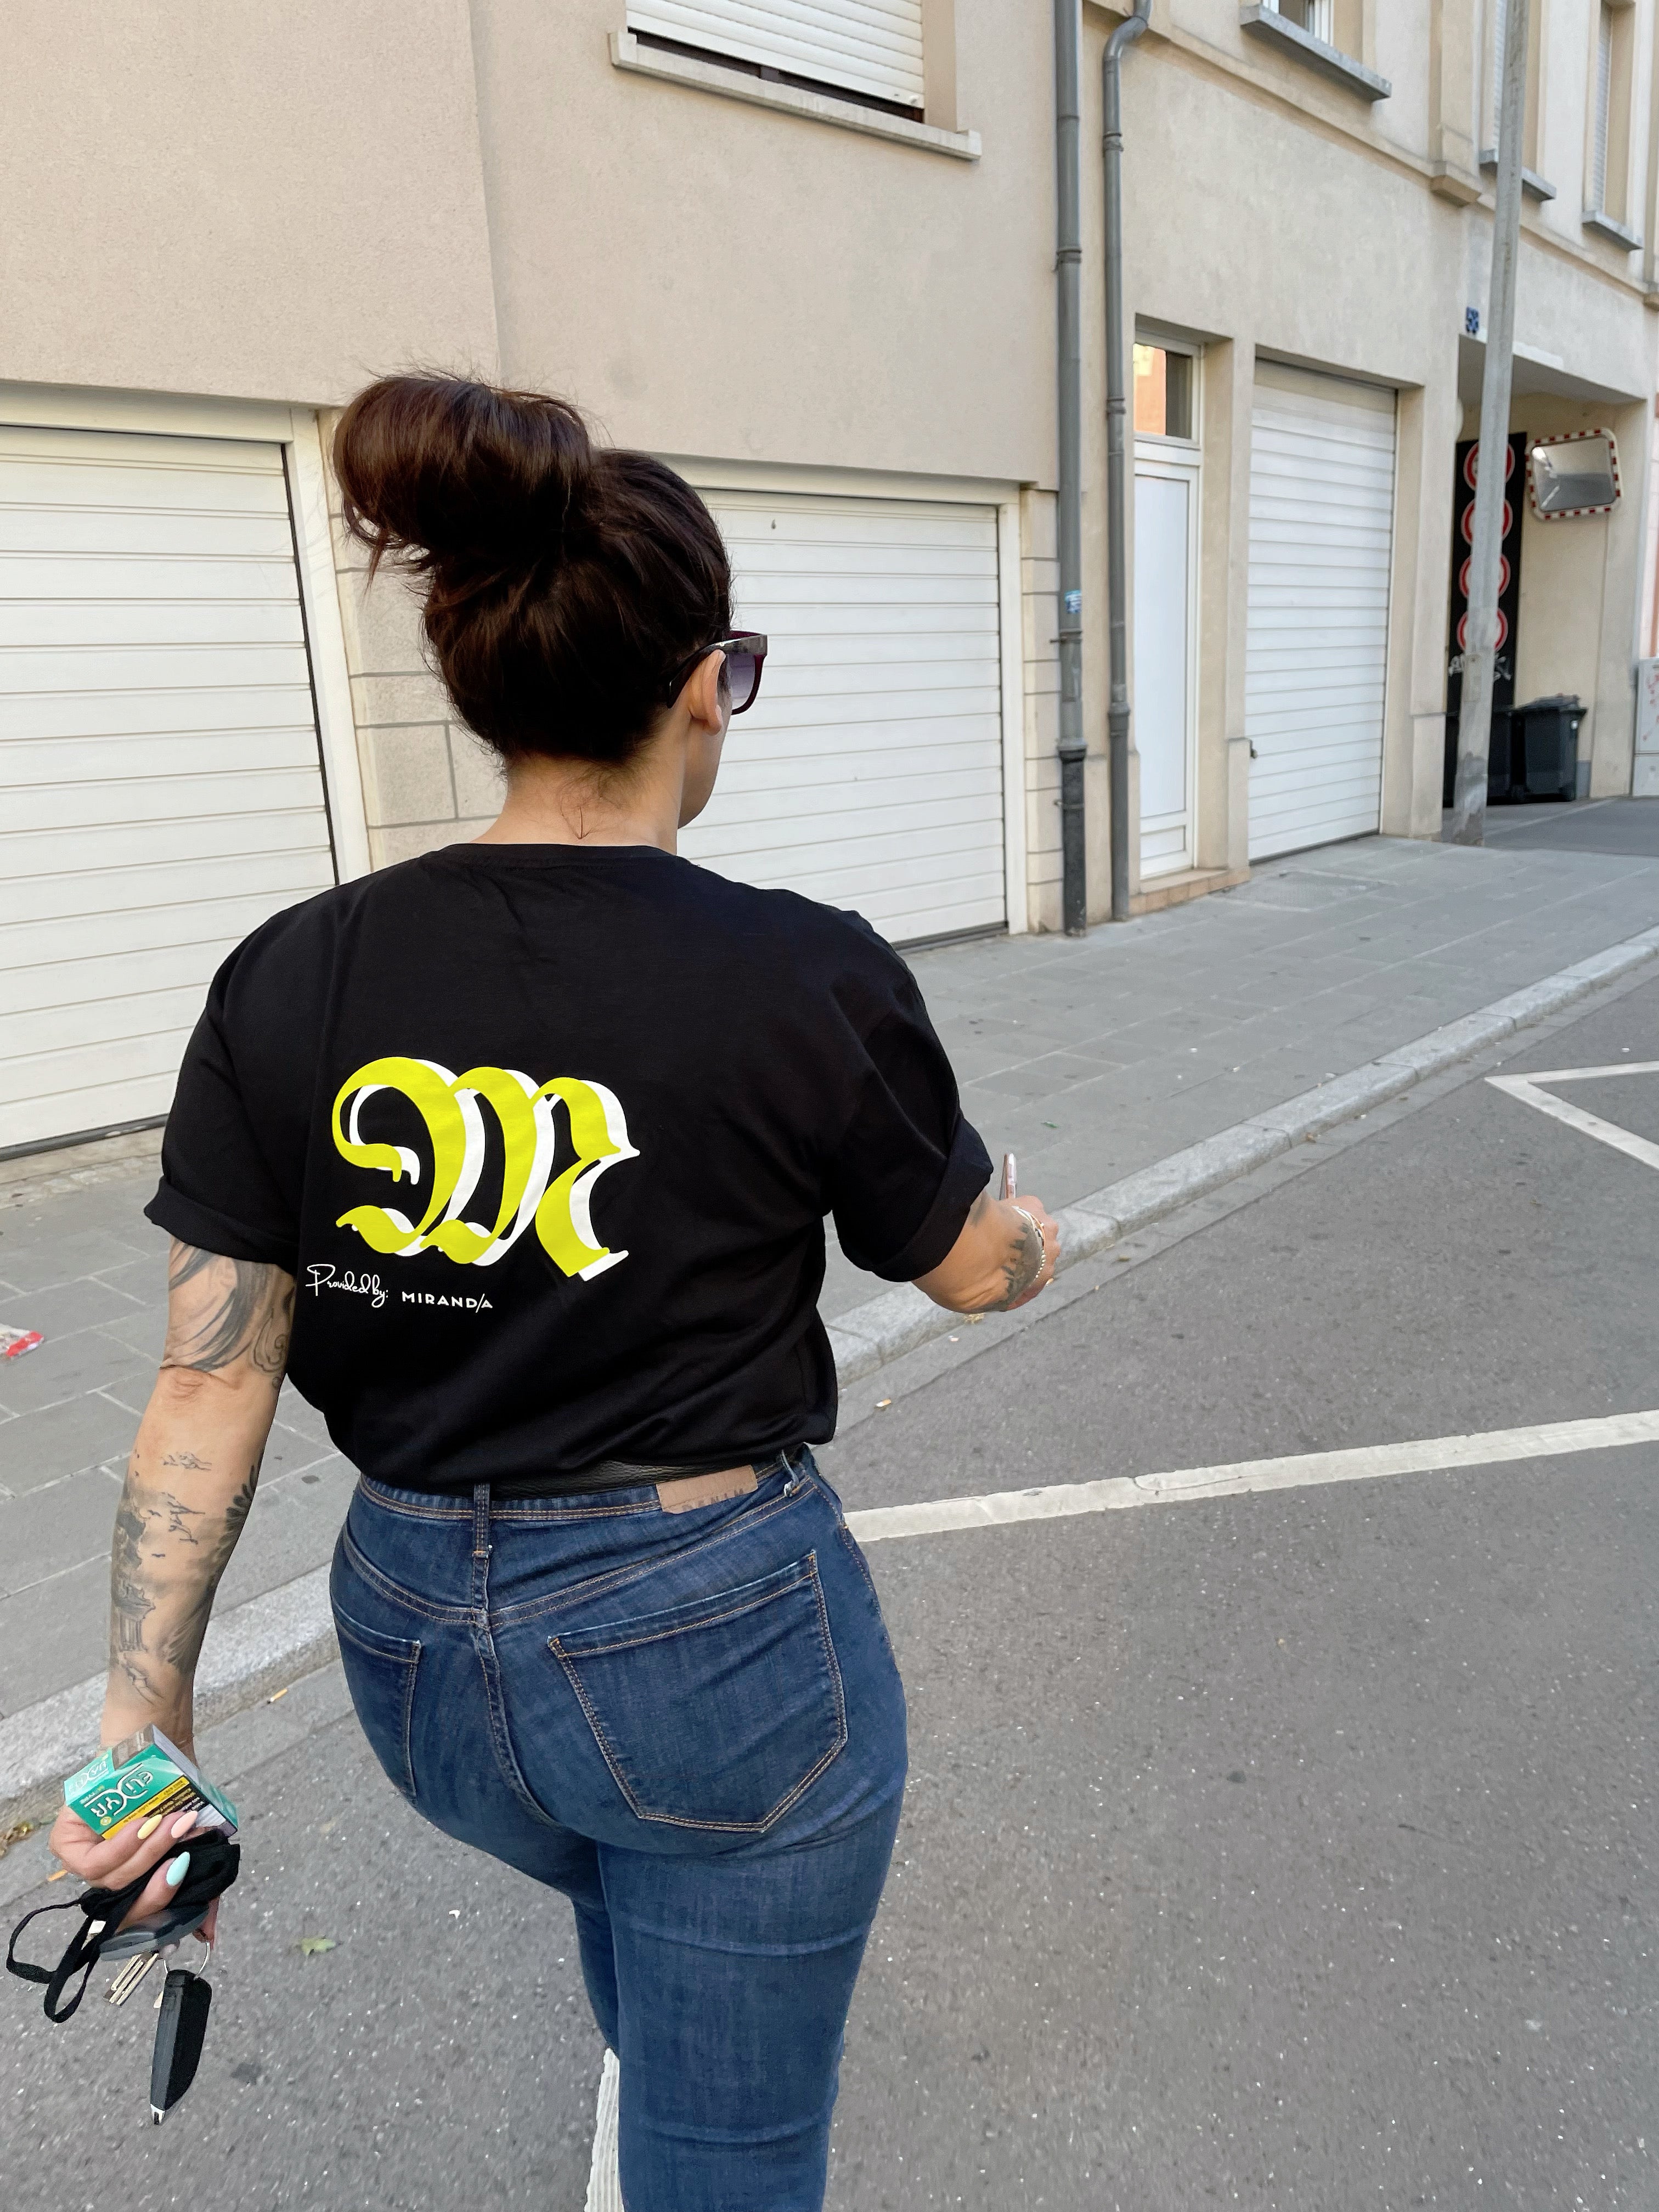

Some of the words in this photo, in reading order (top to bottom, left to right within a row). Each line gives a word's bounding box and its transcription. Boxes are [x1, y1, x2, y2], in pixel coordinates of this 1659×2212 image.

[332, 1057, 640, 1280] M
[306, 1263, 370, 1296] Provided
[371, 1274, 388, 1308] by:
[402, 1291, 493, 1313] MIRAND/A
